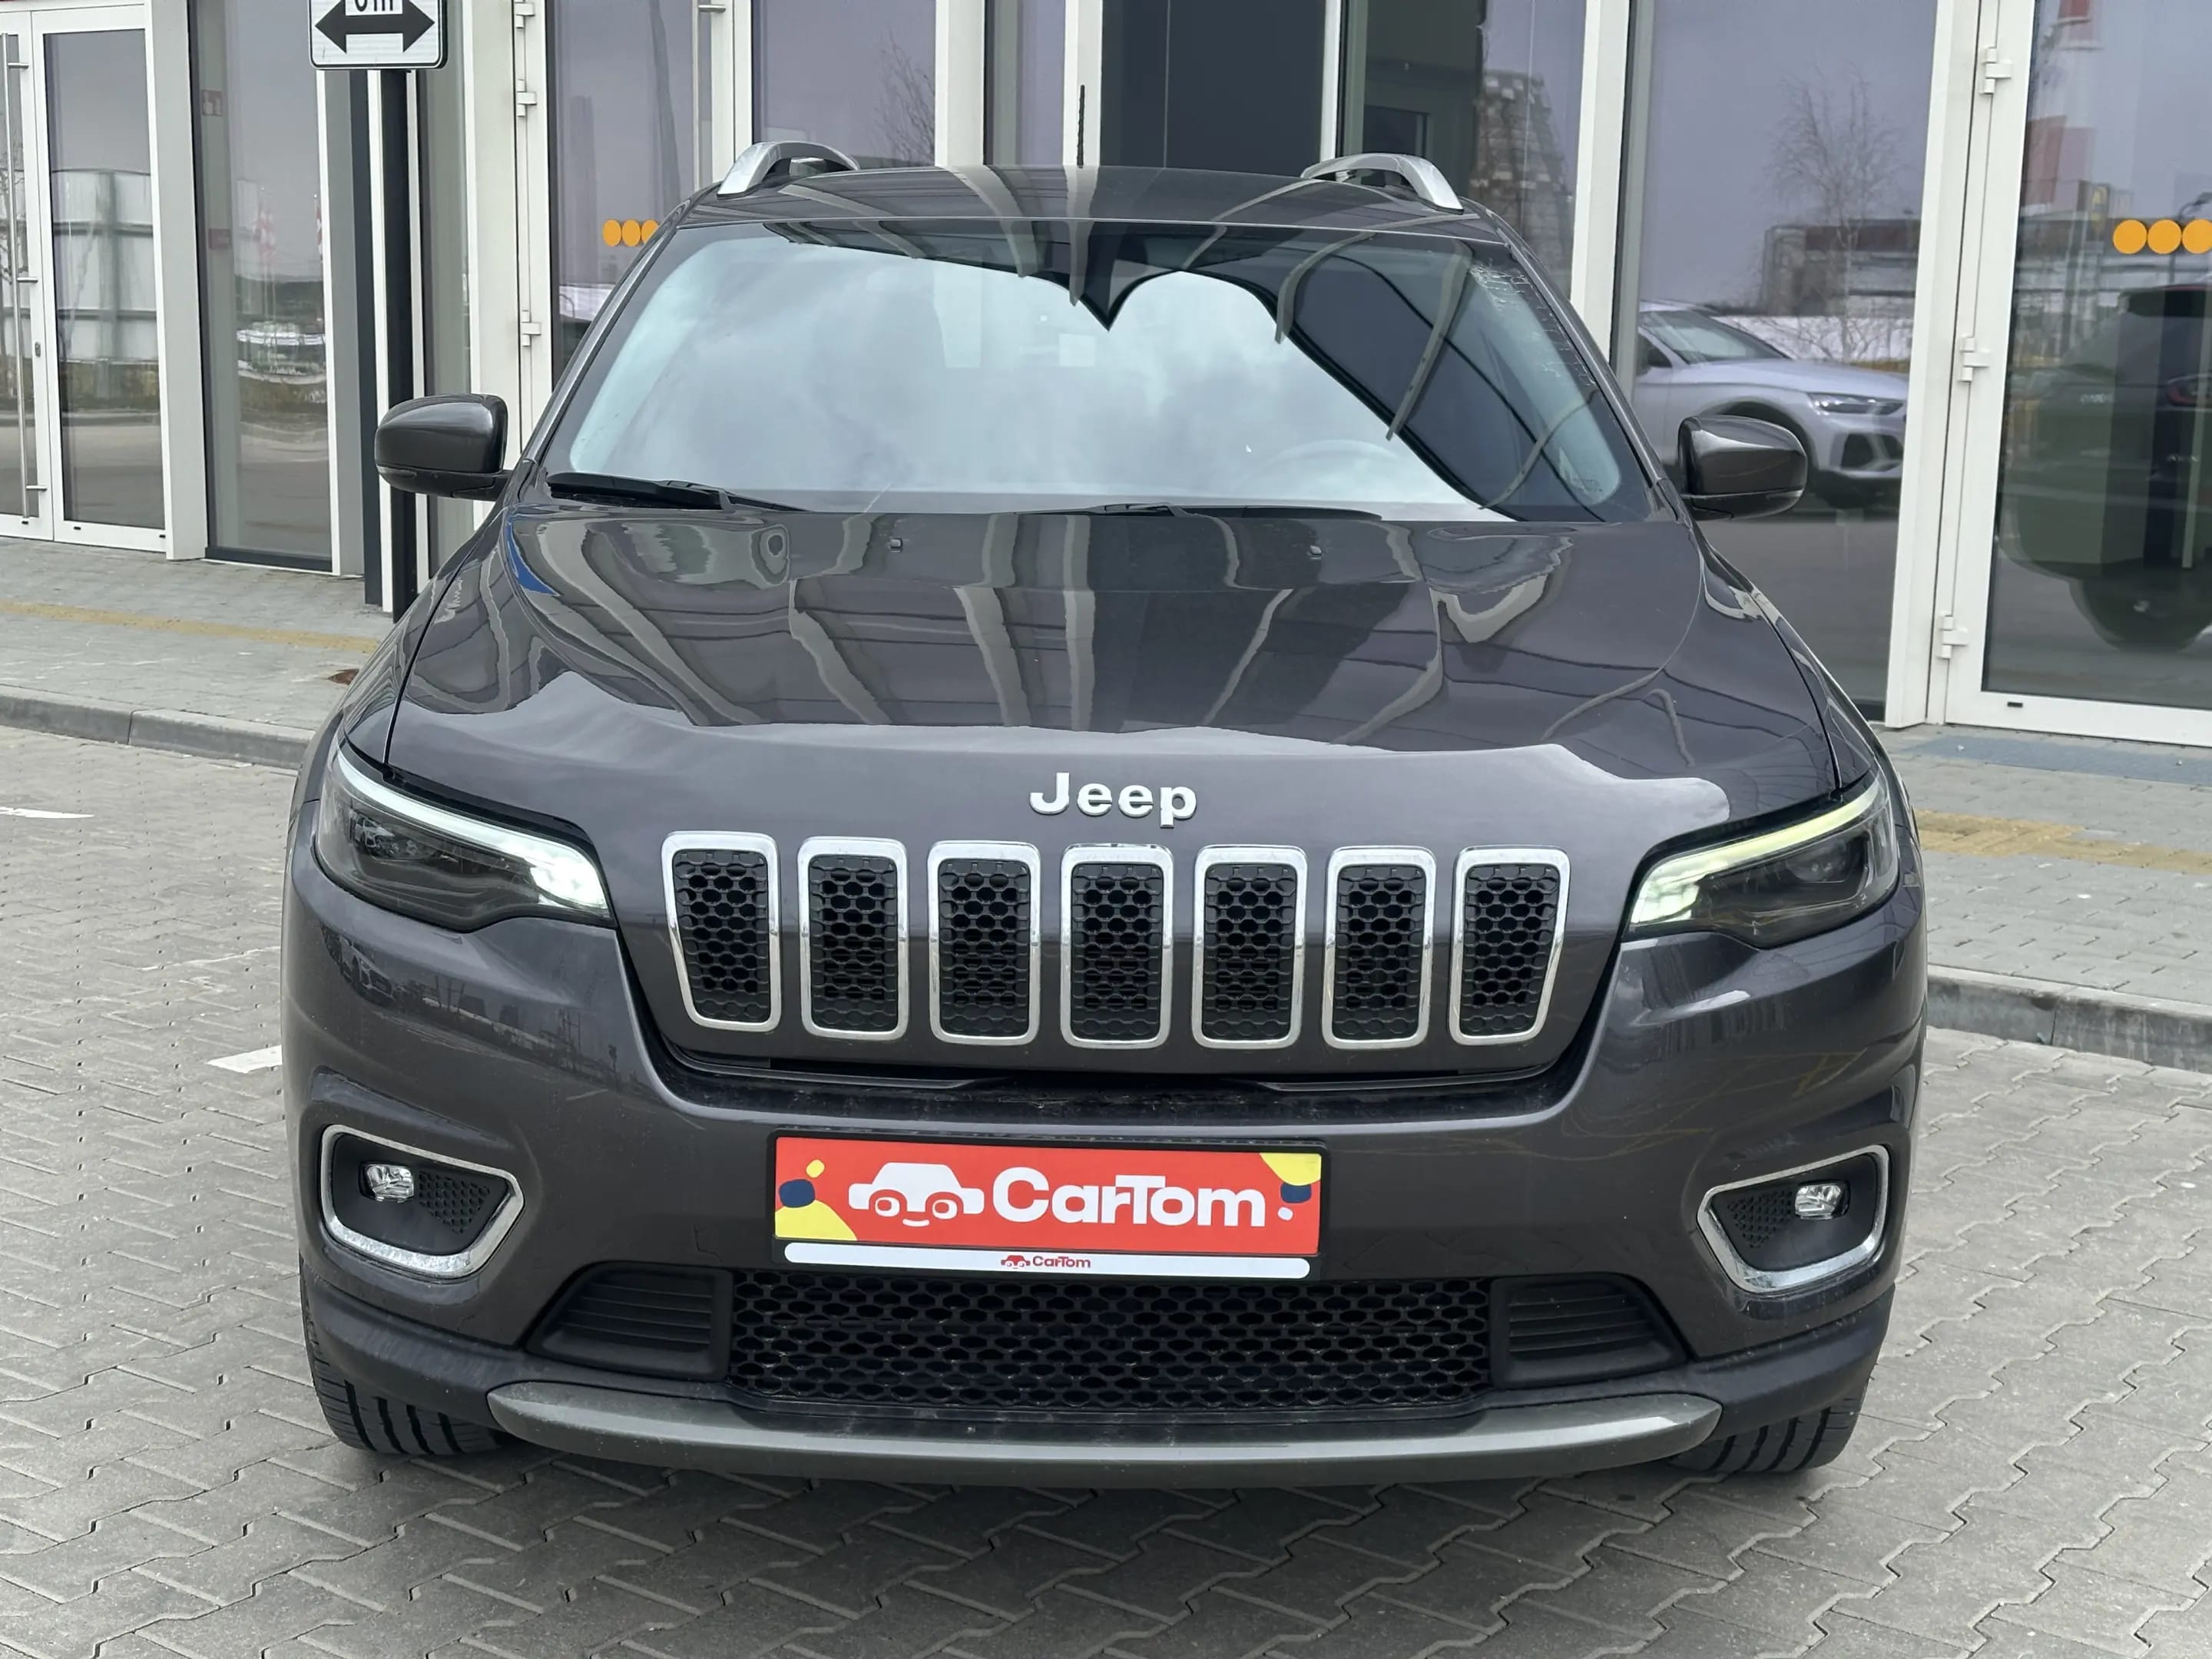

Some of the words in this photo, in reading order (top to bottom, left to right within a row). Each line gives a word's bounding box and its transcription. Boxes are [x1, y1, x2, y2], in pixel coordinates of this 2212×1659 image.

[1029, 772, 1197, 828] Jeep
[992, 1166, 1267, 1227] CarTom
[1032, 1255, 1091, 1268] CarTom
